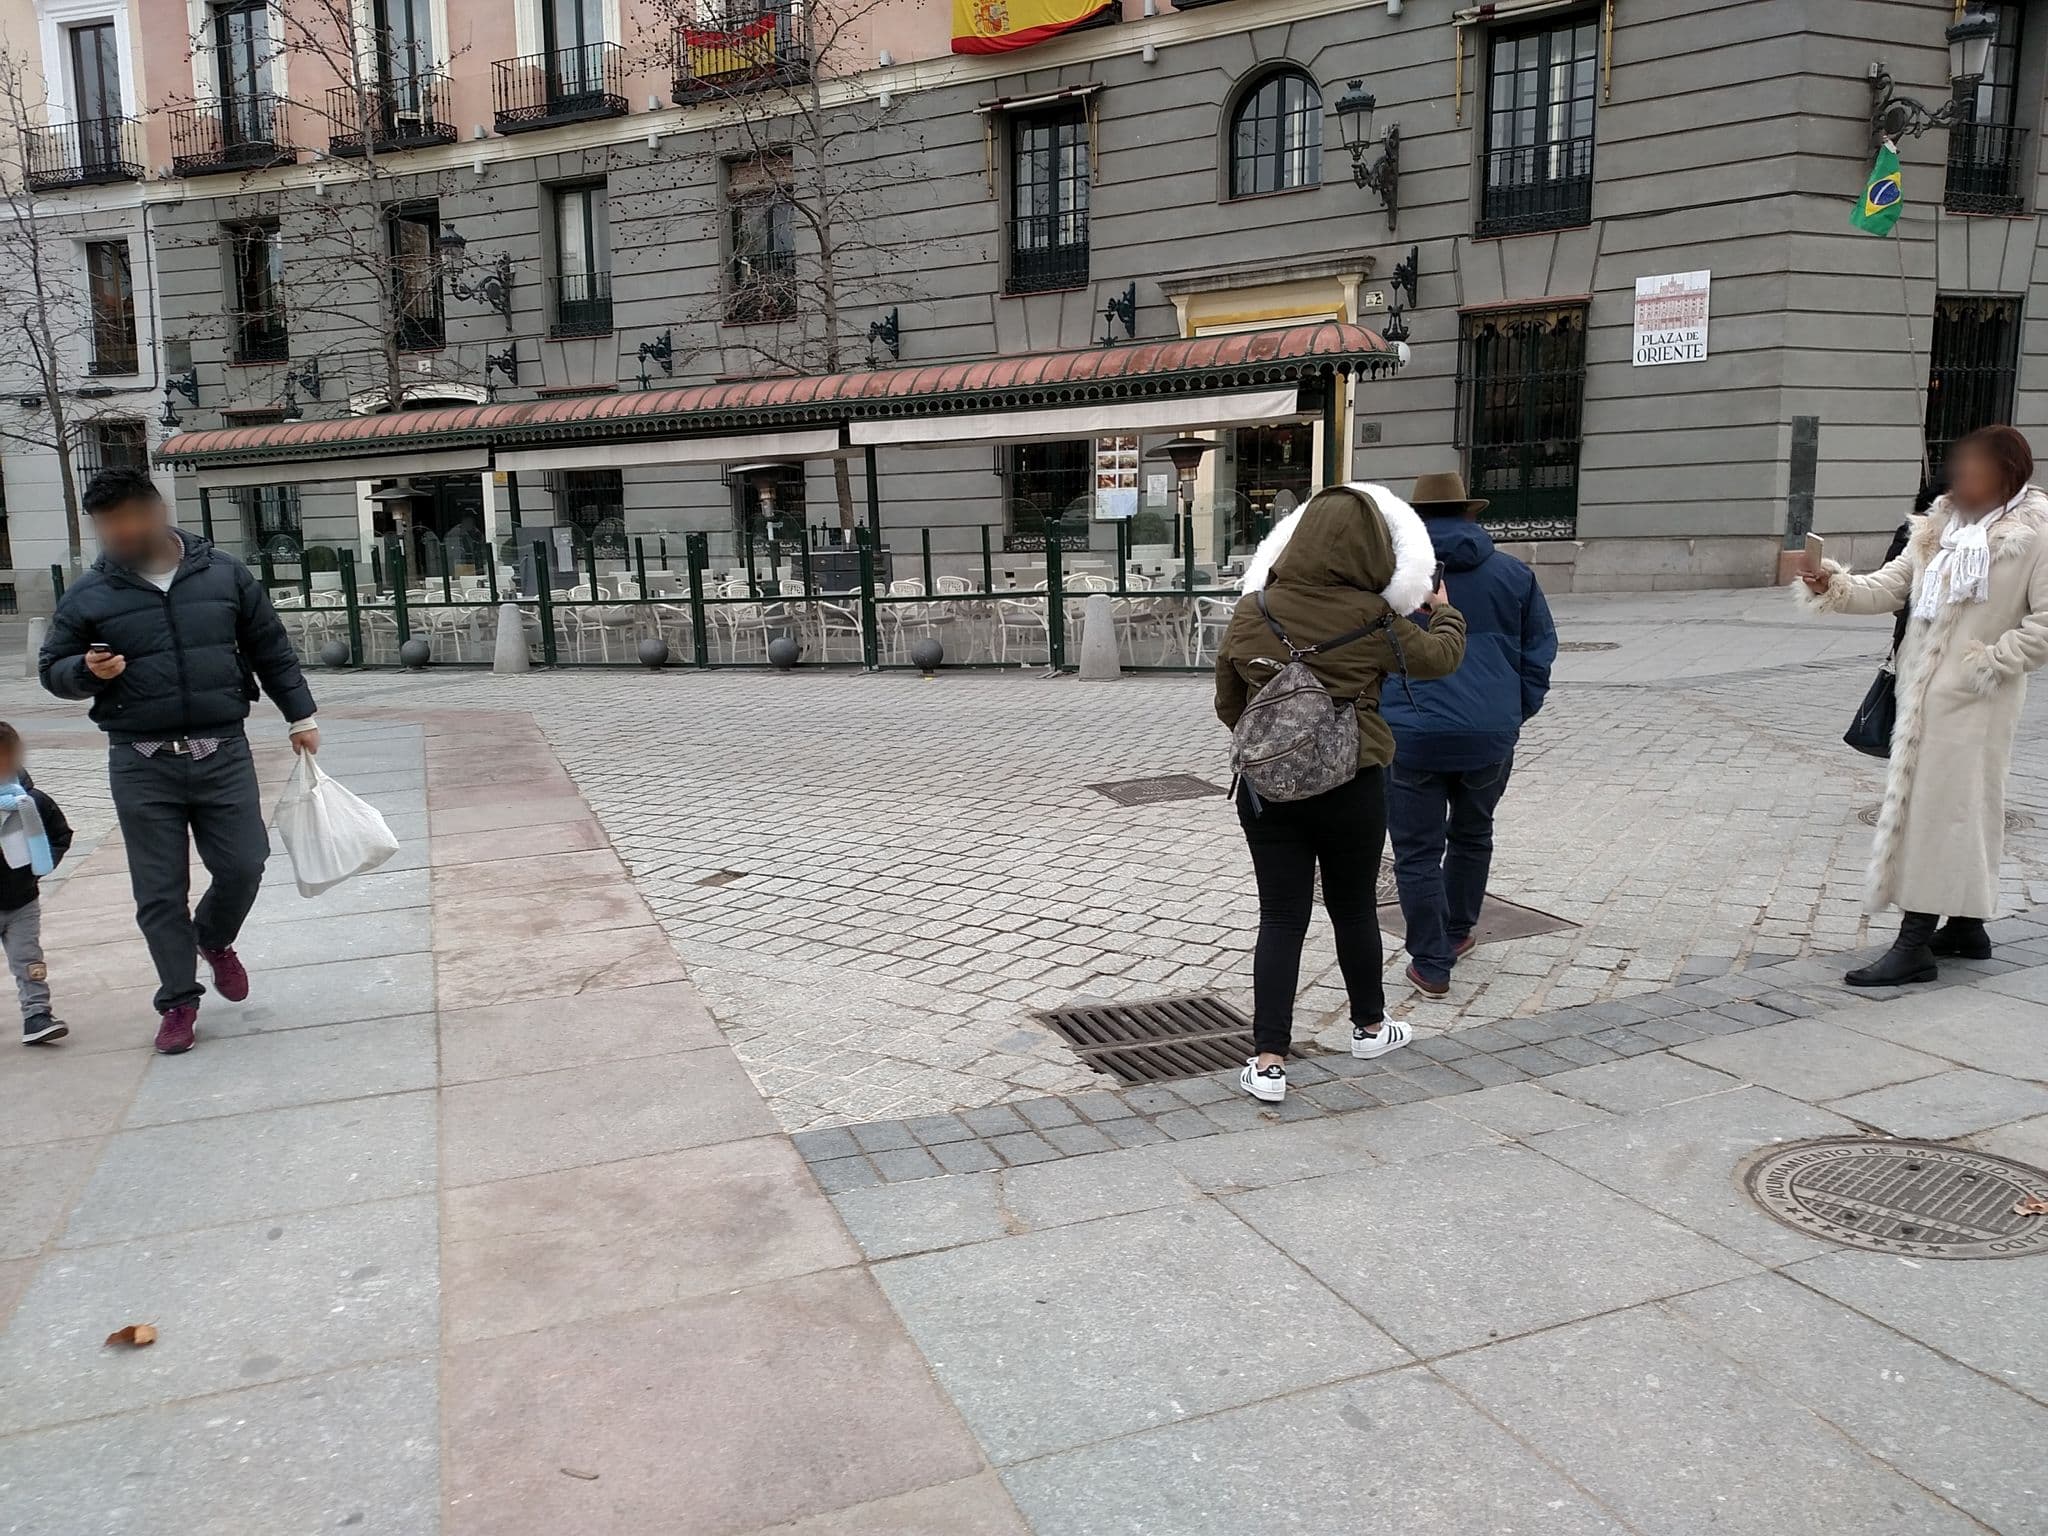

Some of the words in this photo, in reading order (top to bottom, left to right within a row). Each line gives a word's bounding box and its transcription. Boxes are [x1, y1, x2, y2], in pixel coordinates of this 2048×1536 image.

[1637, 344, 1703, 363] ORIENTE
[1642, 332, 1683, 346] PLAZA
[1686, 331, 1699, 340] DE
[1765, 1149, 1851, 1200] AYUNTAMIENTO
[1861, 1147, 1894, 1155] DE
[1814, 1193, 1975, 1236] REGISTRO
